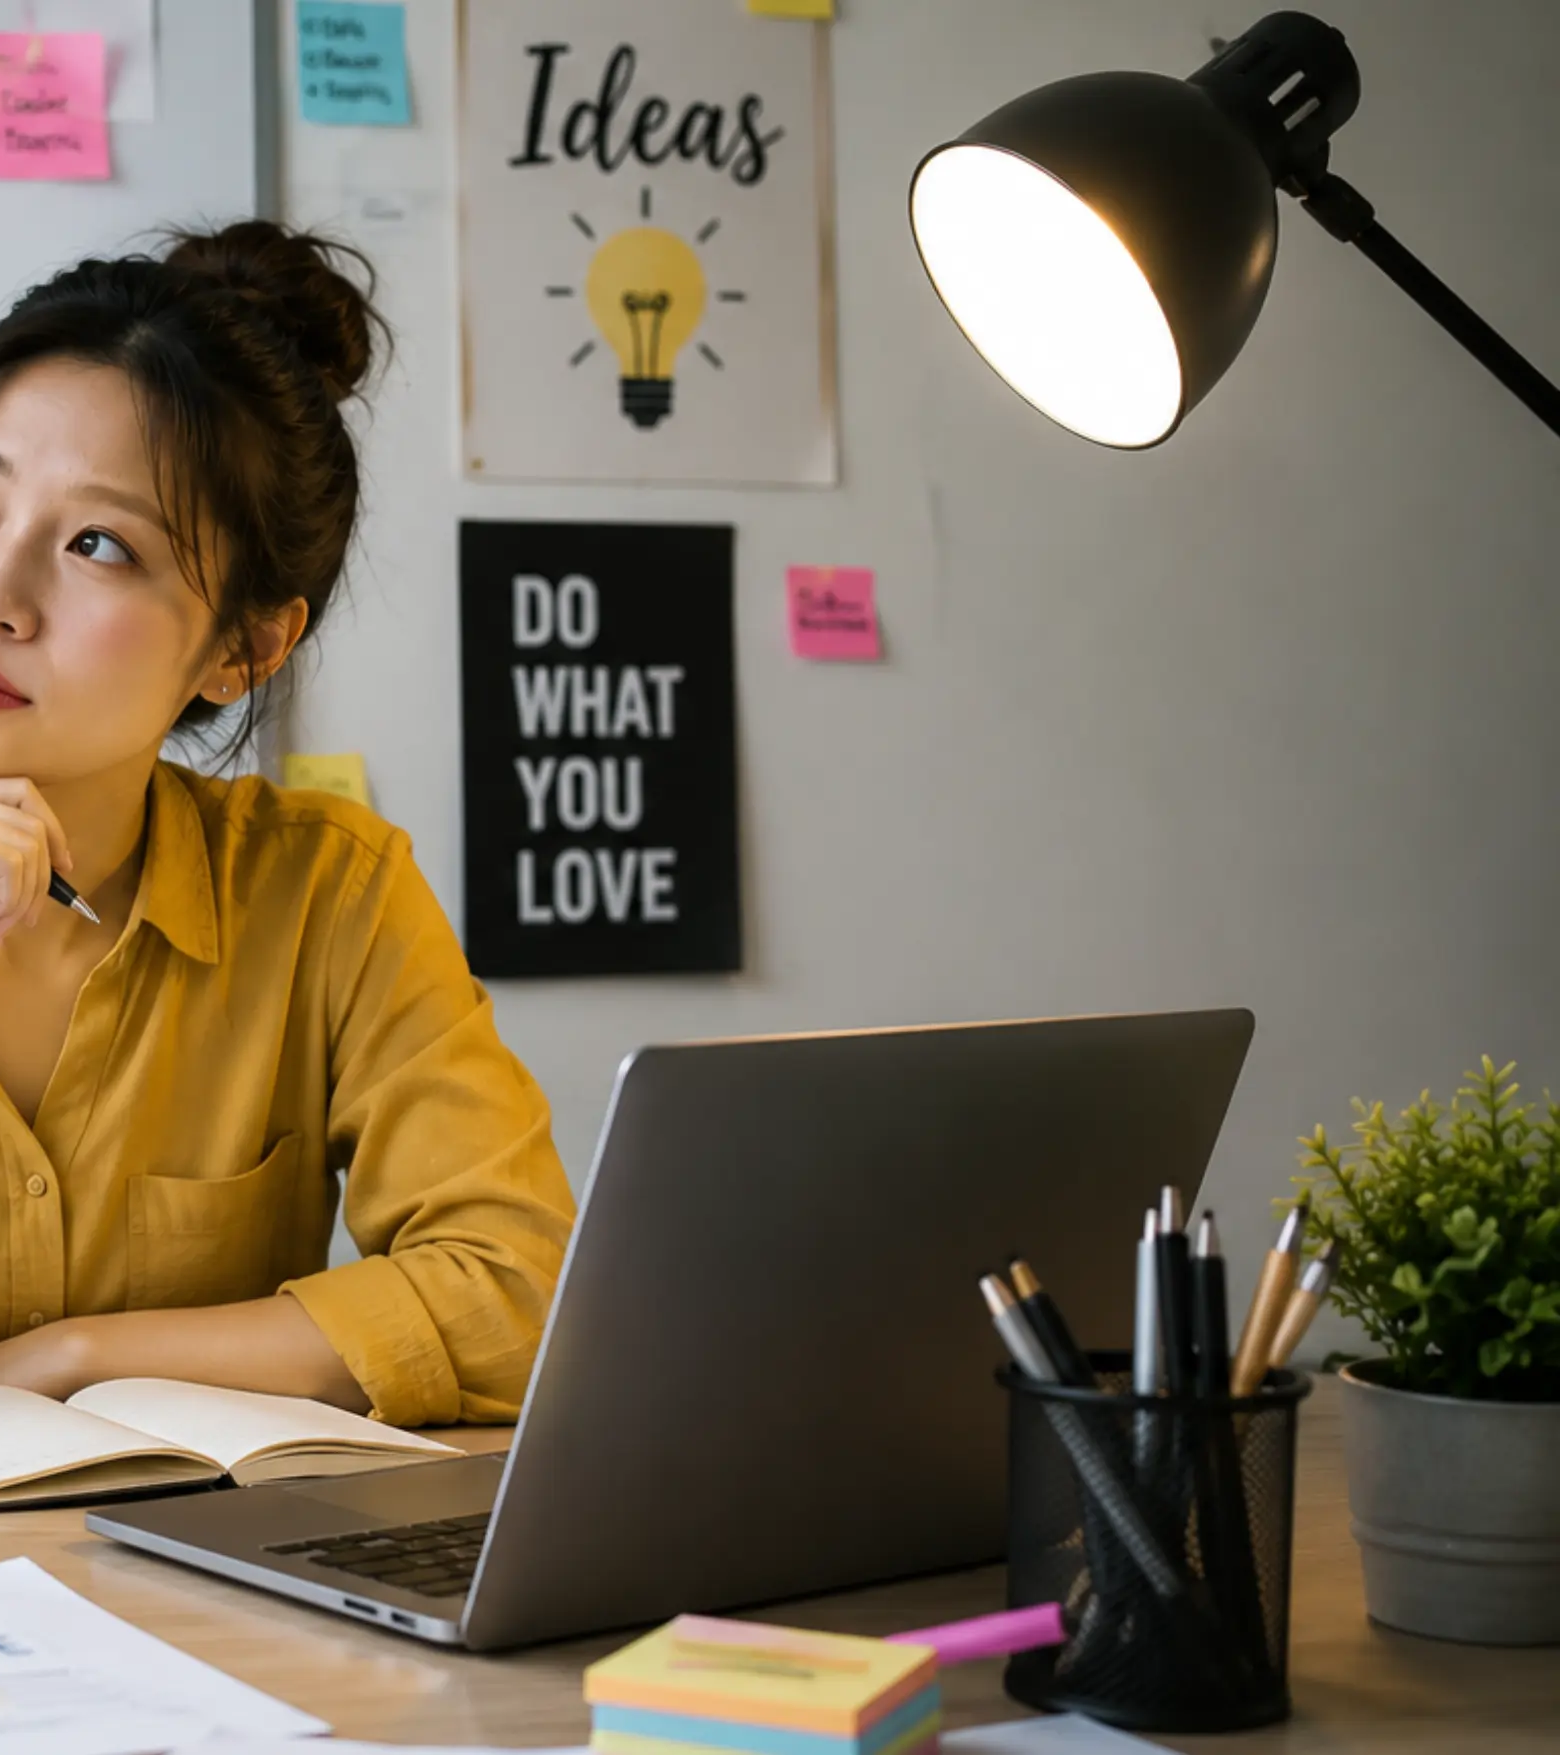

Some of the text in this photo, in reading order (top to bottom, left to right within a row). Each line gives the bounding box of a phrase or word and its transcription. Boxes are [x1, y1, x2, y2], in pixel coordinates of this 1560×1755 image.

[508, 43, 786, 186] Ideas
[512, 573, 600, 650] DO
[512, 665, 685, 739] WHAT
[514, 756, 643, 832] YOU
[516, 847, 679, 924] LOVE
